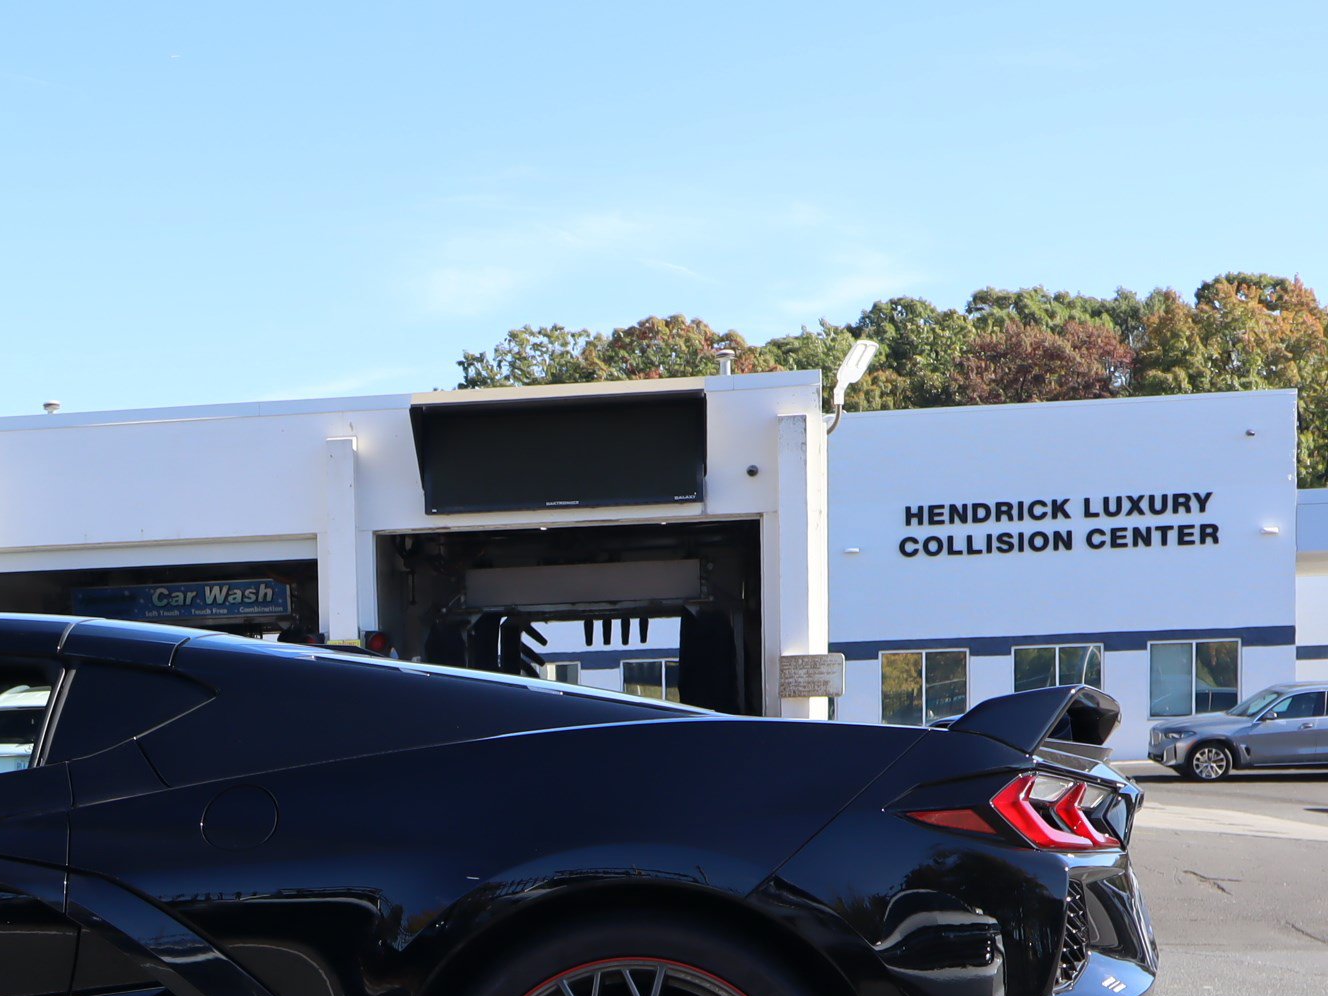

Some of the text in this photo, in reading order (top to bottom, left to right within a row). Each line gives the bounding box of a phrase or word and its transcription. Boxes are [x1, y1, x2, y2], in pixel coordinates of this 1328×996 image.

[905, 492, 1213, 527] HENDRICK LUXURY
[899, 523, 1219, 557] COLLISION CENTER
[152, 583, 273, 607] Car Wash
